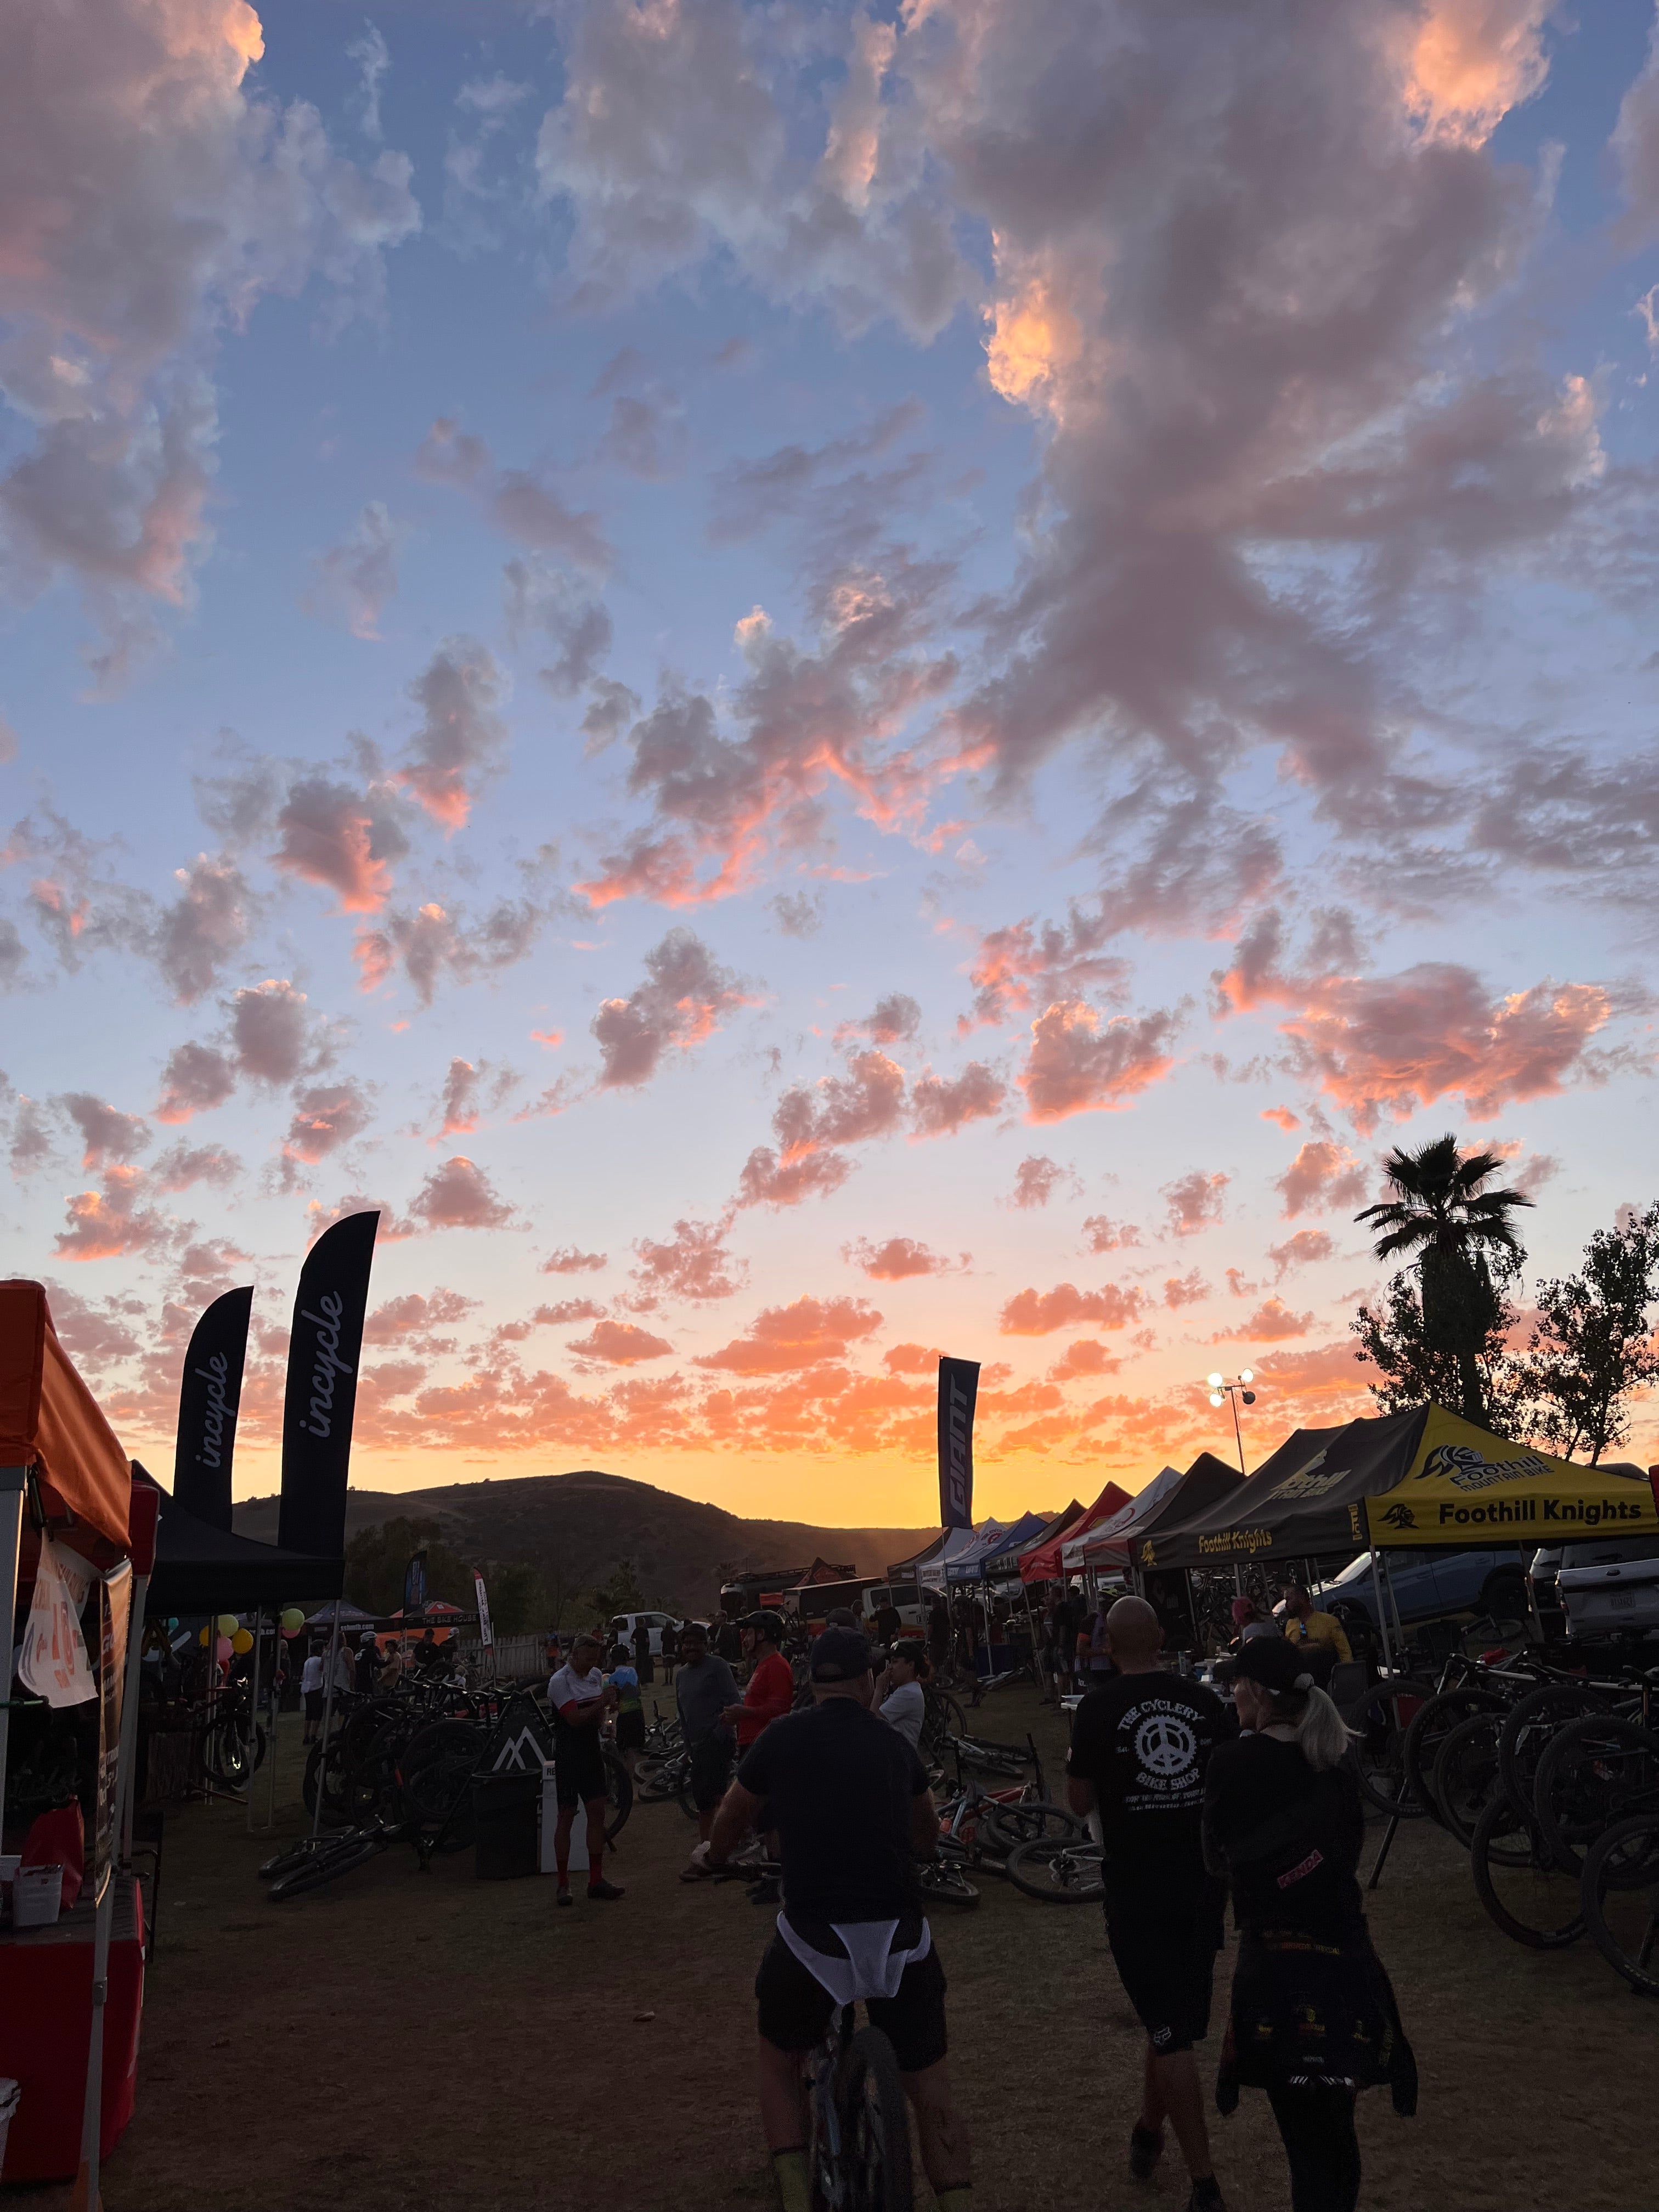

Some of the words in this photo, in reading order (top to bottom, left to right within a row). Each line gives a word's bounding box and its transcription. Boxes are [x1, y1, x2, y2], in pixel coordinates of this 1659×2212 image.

[298, 1290, 353, 1438] incycle
[195, 1352, 236, 1468] incycle
[949, 1373, 968, 1517] GIANT
[1449, 1455, 1544, 1486] Foothill
[1523, 1465, 1555, 1476] BIKE
[1440, 1500, 1536, 1525] Foothill
[1543, 1499, 1642, 1526] Knights
[1199, 1531, 1231, 1554] Foothill
[1232, 1528, 1272, 1554] Knights
[453, 1614, 477, 1622] HOUSE
[1117, 1706, 1142, 1730] THE
[1135, 1771, 1167, 1791] BIKE
